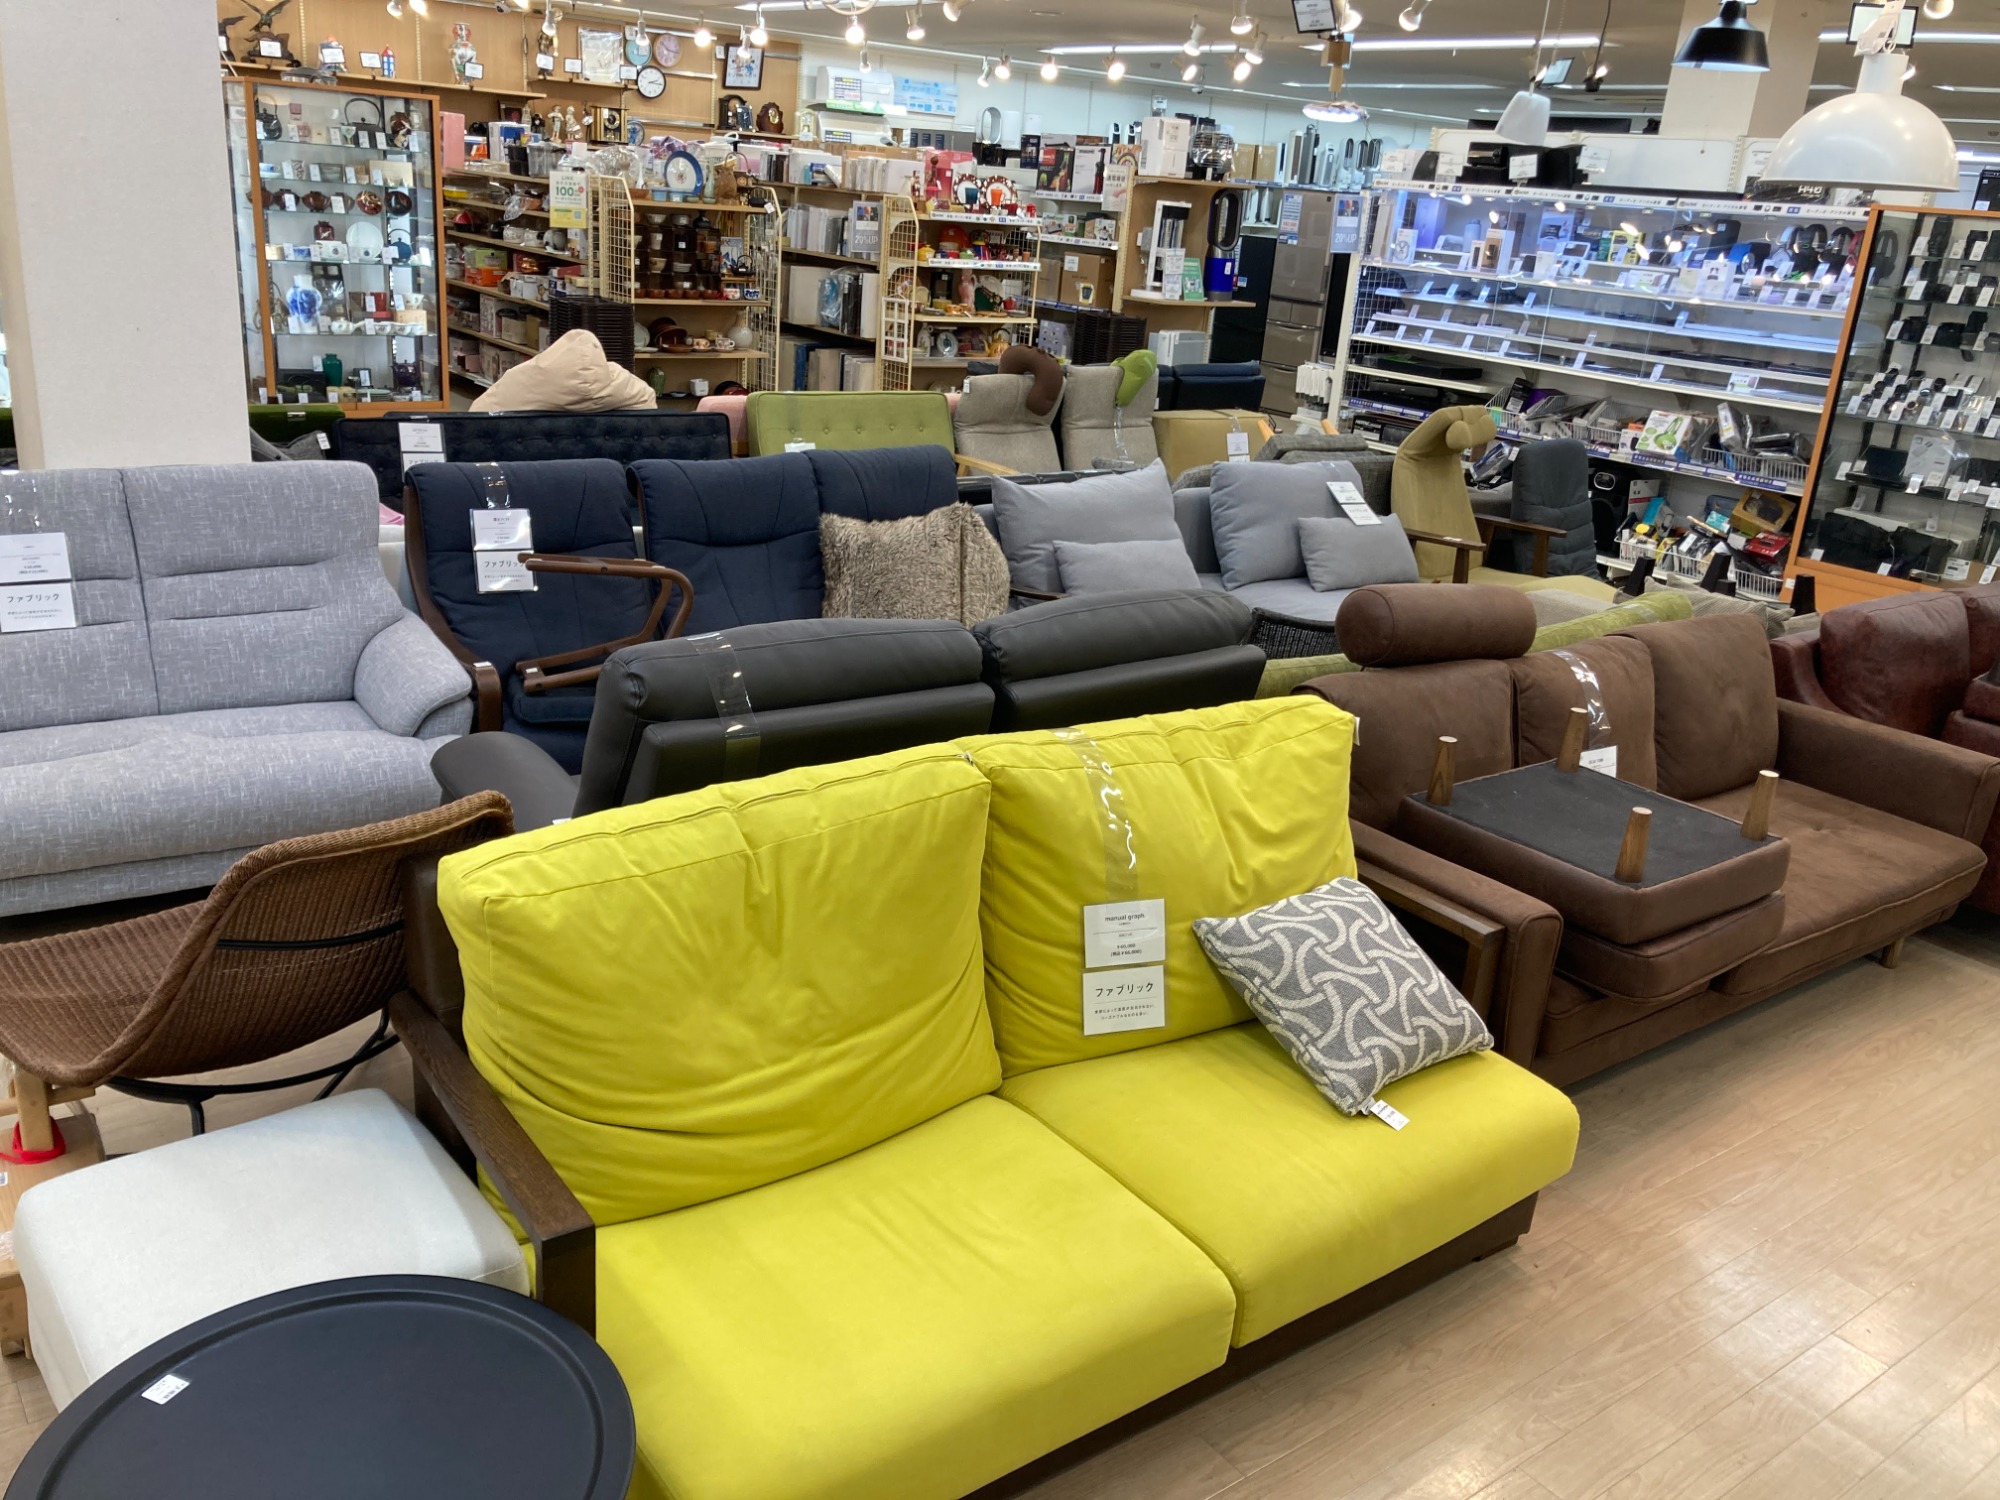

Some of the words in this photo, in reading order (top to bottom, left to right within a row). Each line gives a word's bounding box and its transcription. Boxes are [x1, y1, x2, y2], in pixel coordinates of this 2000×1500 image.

[556, 186, 574, 197] 100
[7, 593, 60, 603] ファブリック
[1105, 914, 1127, 922] manual
[1128, 912, 1145, 921] graph
[1095, 982, 1154, 998] ファブリック
